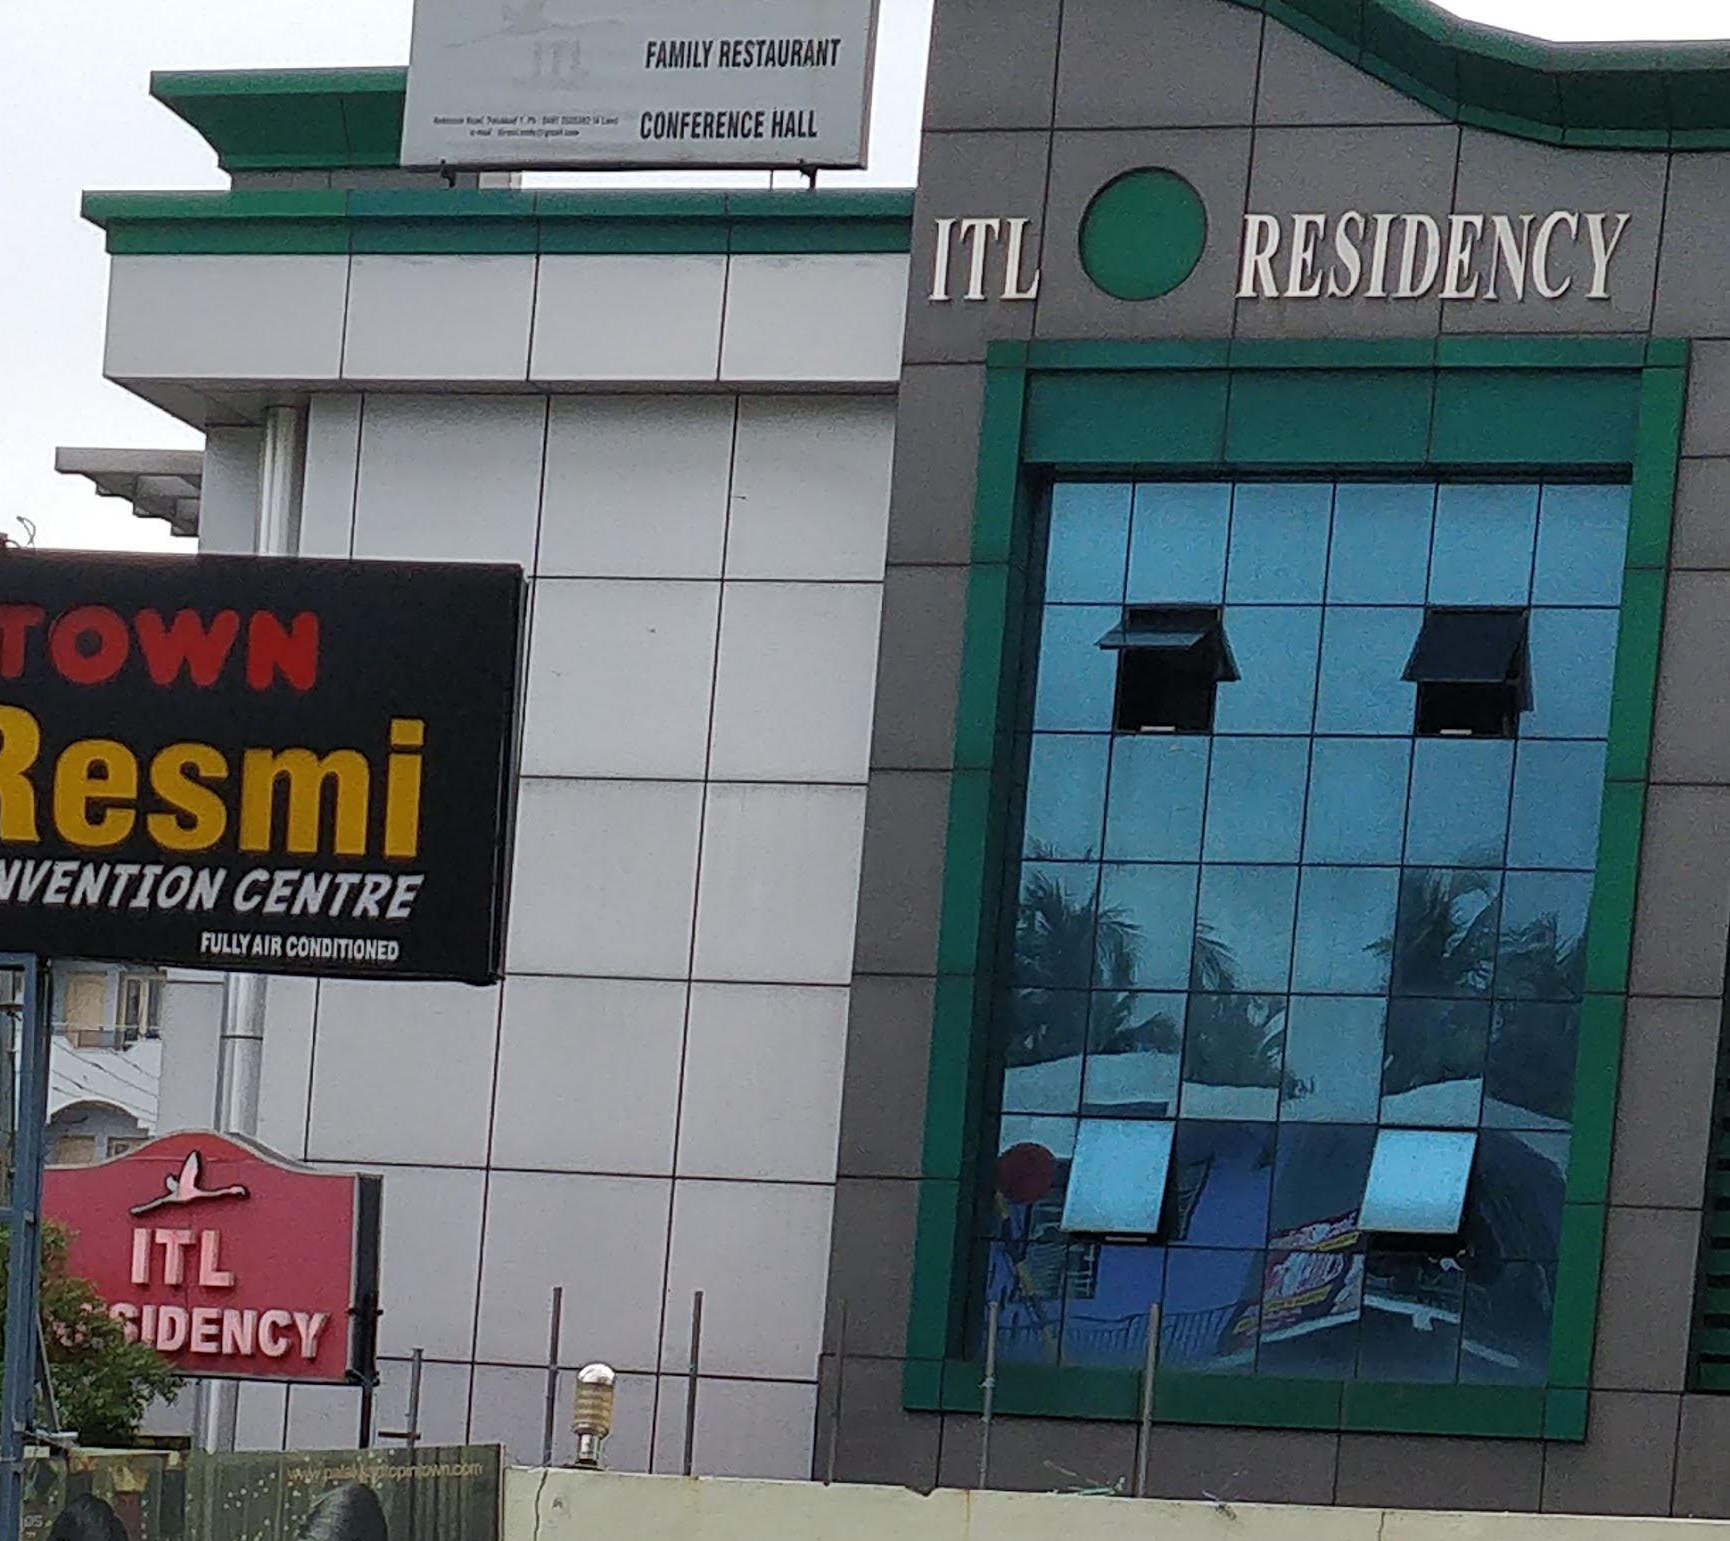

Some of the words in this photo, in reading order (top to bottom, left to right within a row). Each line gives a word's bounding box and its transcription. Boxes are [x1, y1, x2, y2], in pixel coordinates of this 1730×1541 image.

[645, 39, 713, 69] FAMILY
[718, 38, 842, 68] RESTAURANT
[639, 109, 766, 141] CONFERENCE
[770, 110, 818, 139] HALL
[927, 216, 1041, 302] ITL
[1234, 209, 1632, 302] RESIDENCY
[233, 867, 425, 919] CENTRE
[200, 931, 249, 953] FULLY
[251, 935, 282, 957] AIR
[286, 935, 400, 961] CONDITIONED
[131, 1227, 236, 1288] ITL
[109, 1302, 330, 1360] SIDENCY
